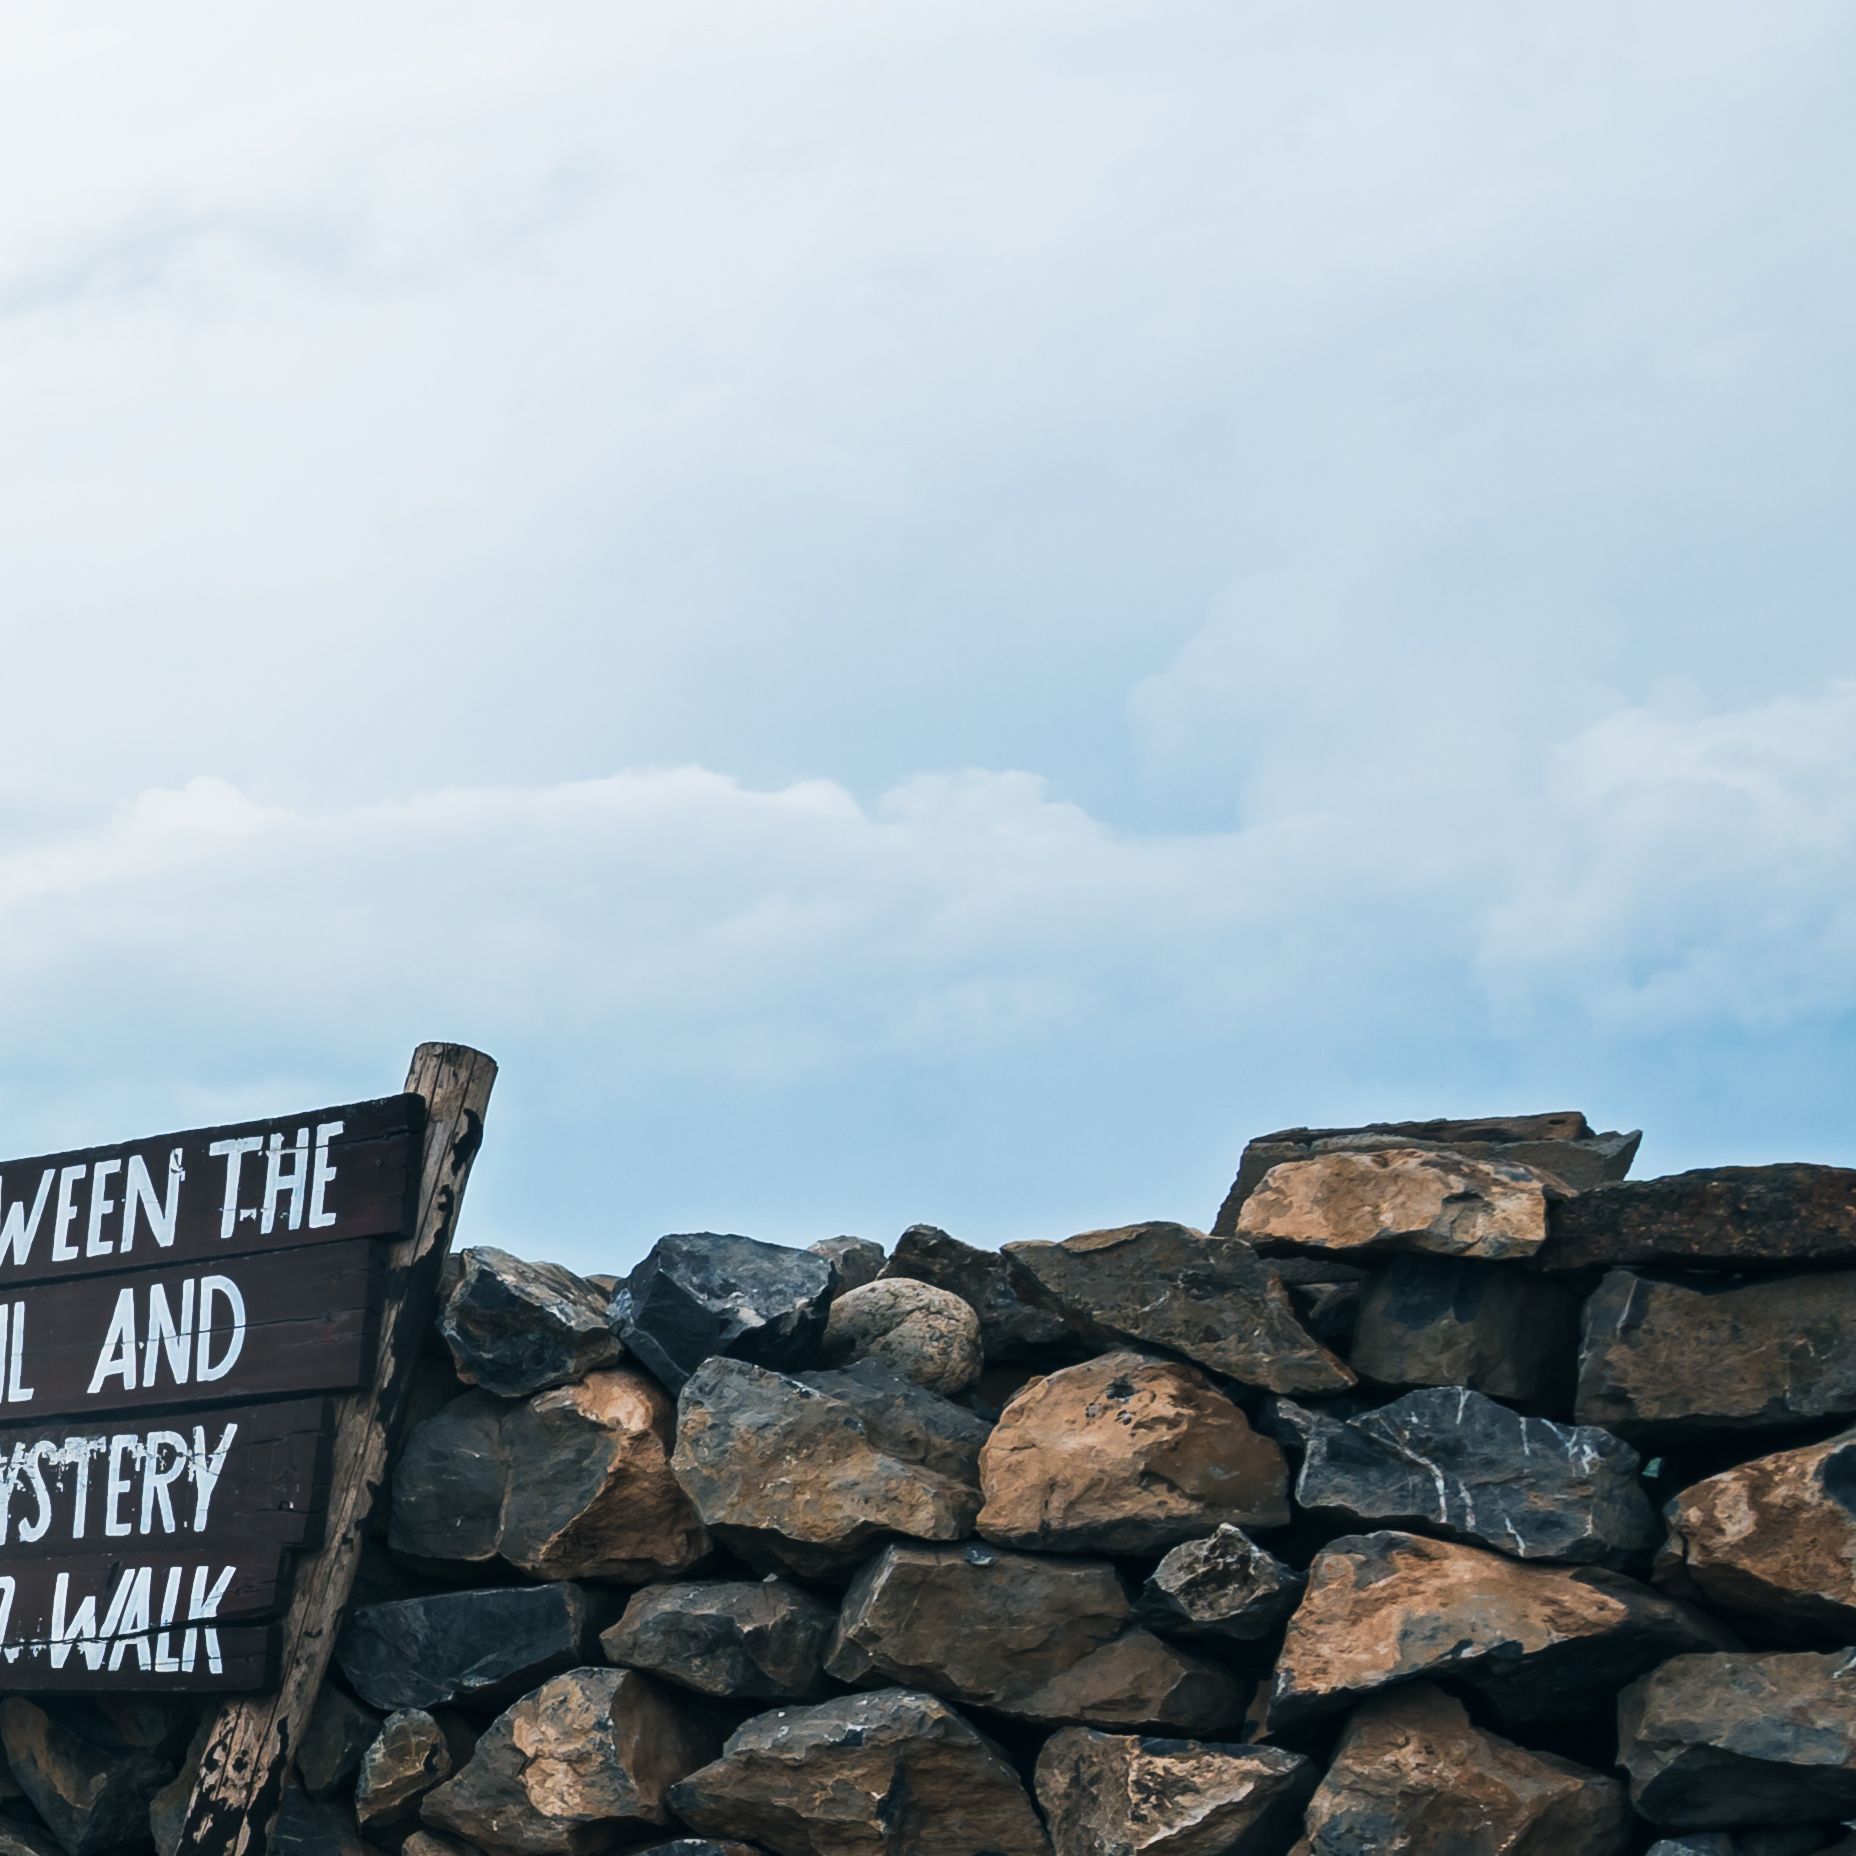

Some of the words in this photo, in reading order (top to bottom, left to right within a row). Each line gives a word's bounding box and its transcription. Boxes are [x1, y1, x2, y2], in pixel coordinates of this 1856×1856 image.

[207, 1120, 343, 1238] THE
[87, 1275, 245, 1393] AND
[50, 1566, 236, 1674] WALK
